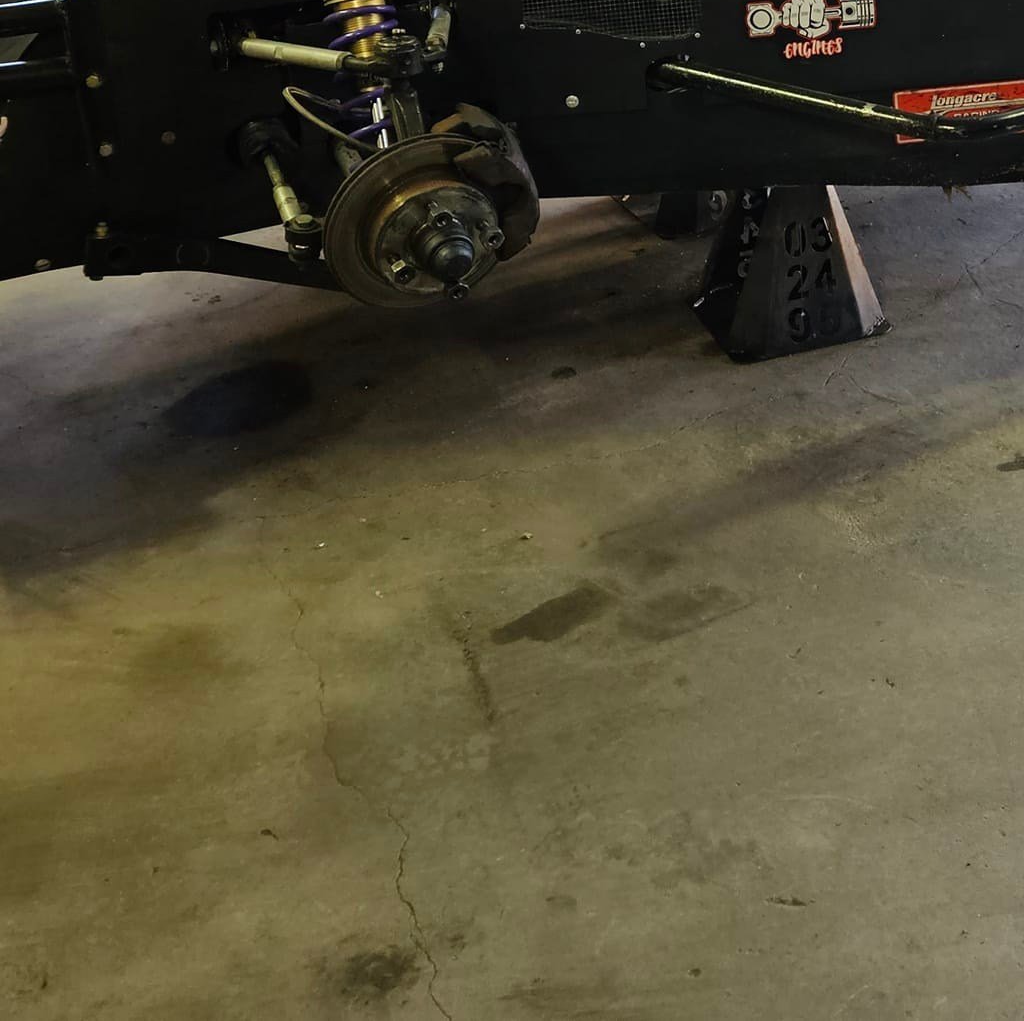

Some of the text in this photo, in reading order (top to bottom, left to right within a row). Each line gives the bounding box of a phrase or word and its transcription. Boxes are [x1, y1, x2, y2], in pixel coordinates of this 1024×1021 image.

[783, 37, 844, 60] ENGINES
[784, 217, 833, 257] 03
[787, 259, 837, 300] 24
